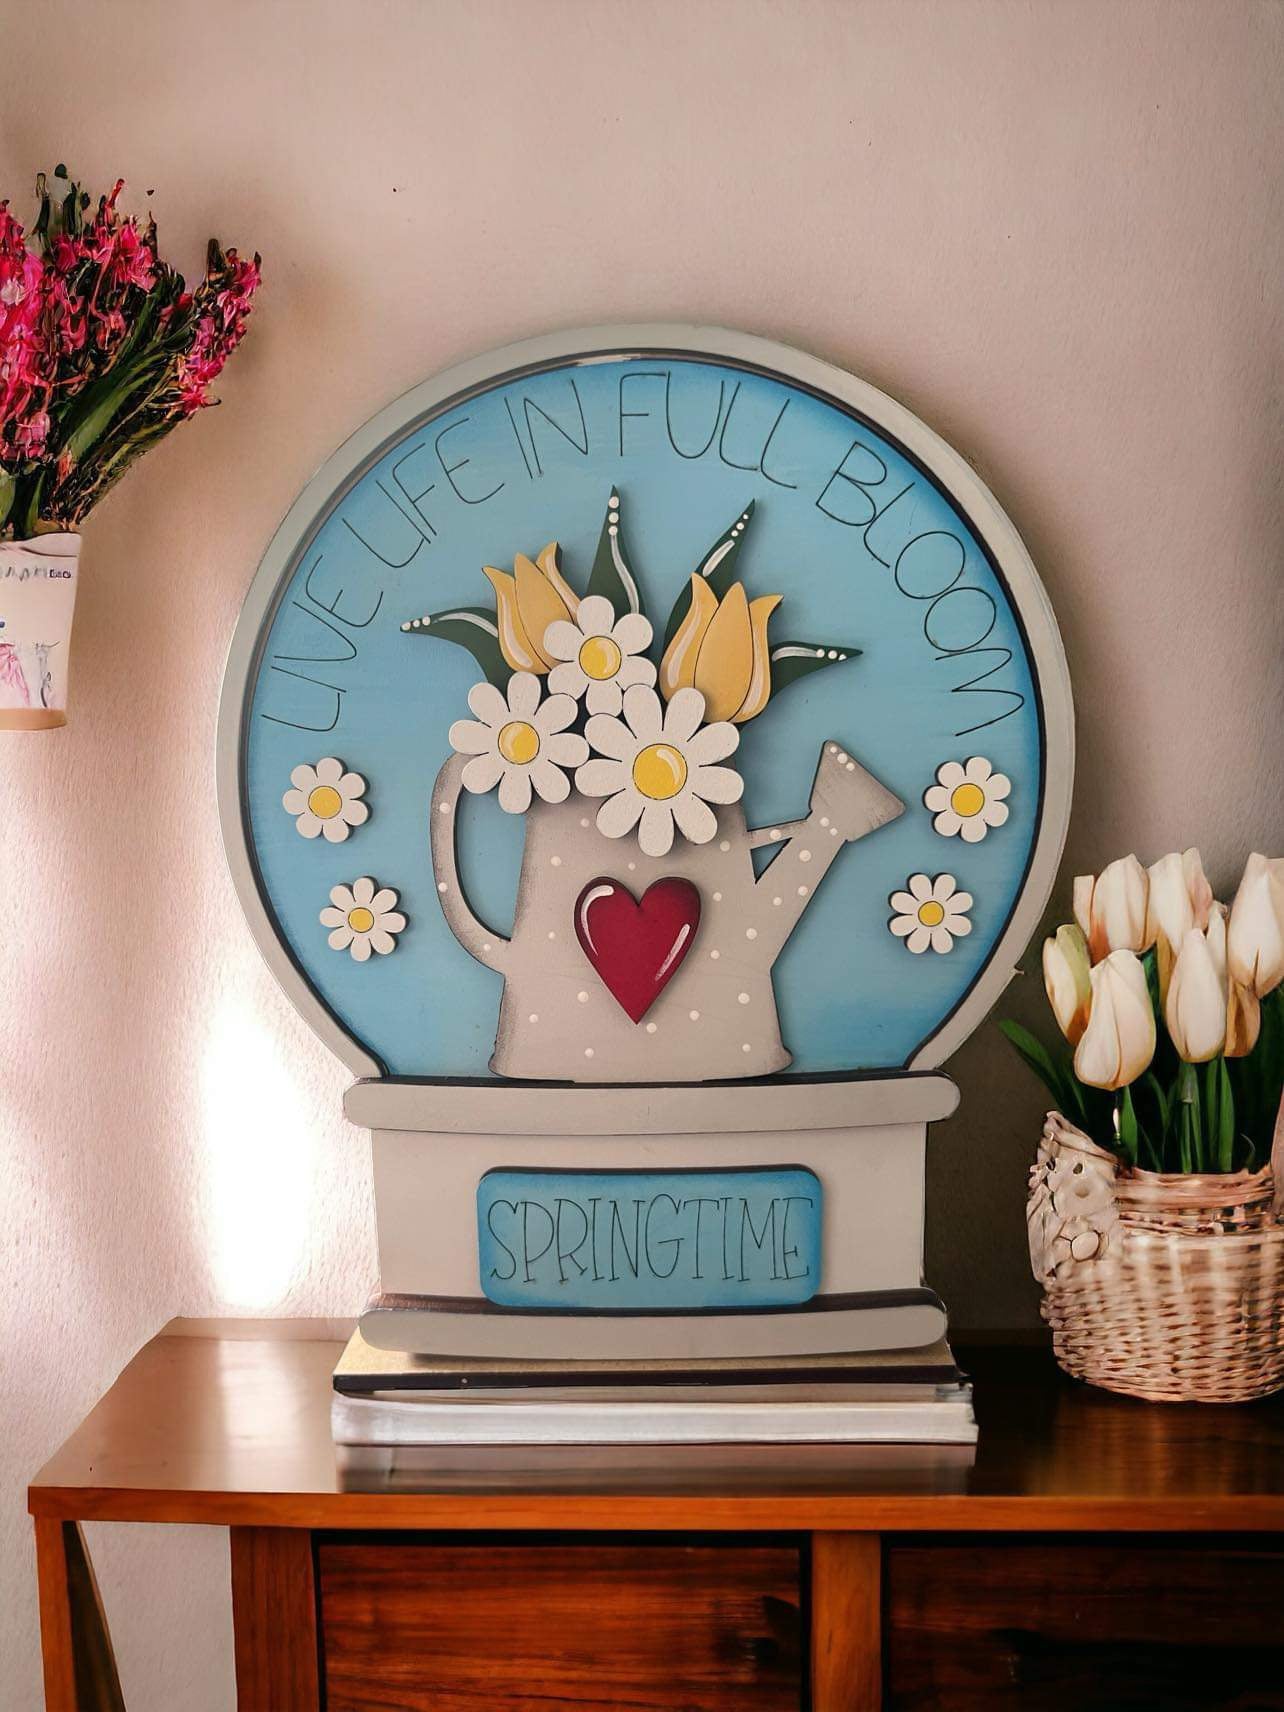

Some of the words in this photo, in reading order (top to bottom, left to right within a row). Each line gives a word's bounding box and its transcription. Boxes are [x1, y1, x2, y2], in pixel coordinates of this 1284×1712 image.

[261, 554, 384, 732] LIVE
[341, 417, 505, 568] LIFE
[503, 378, 589, 480] IN
[619, 370, 798, 490] FULL
[815, 440, 1026, 737] BLOOM
[487, 1193, 814, 1283] SPRINGTIME
